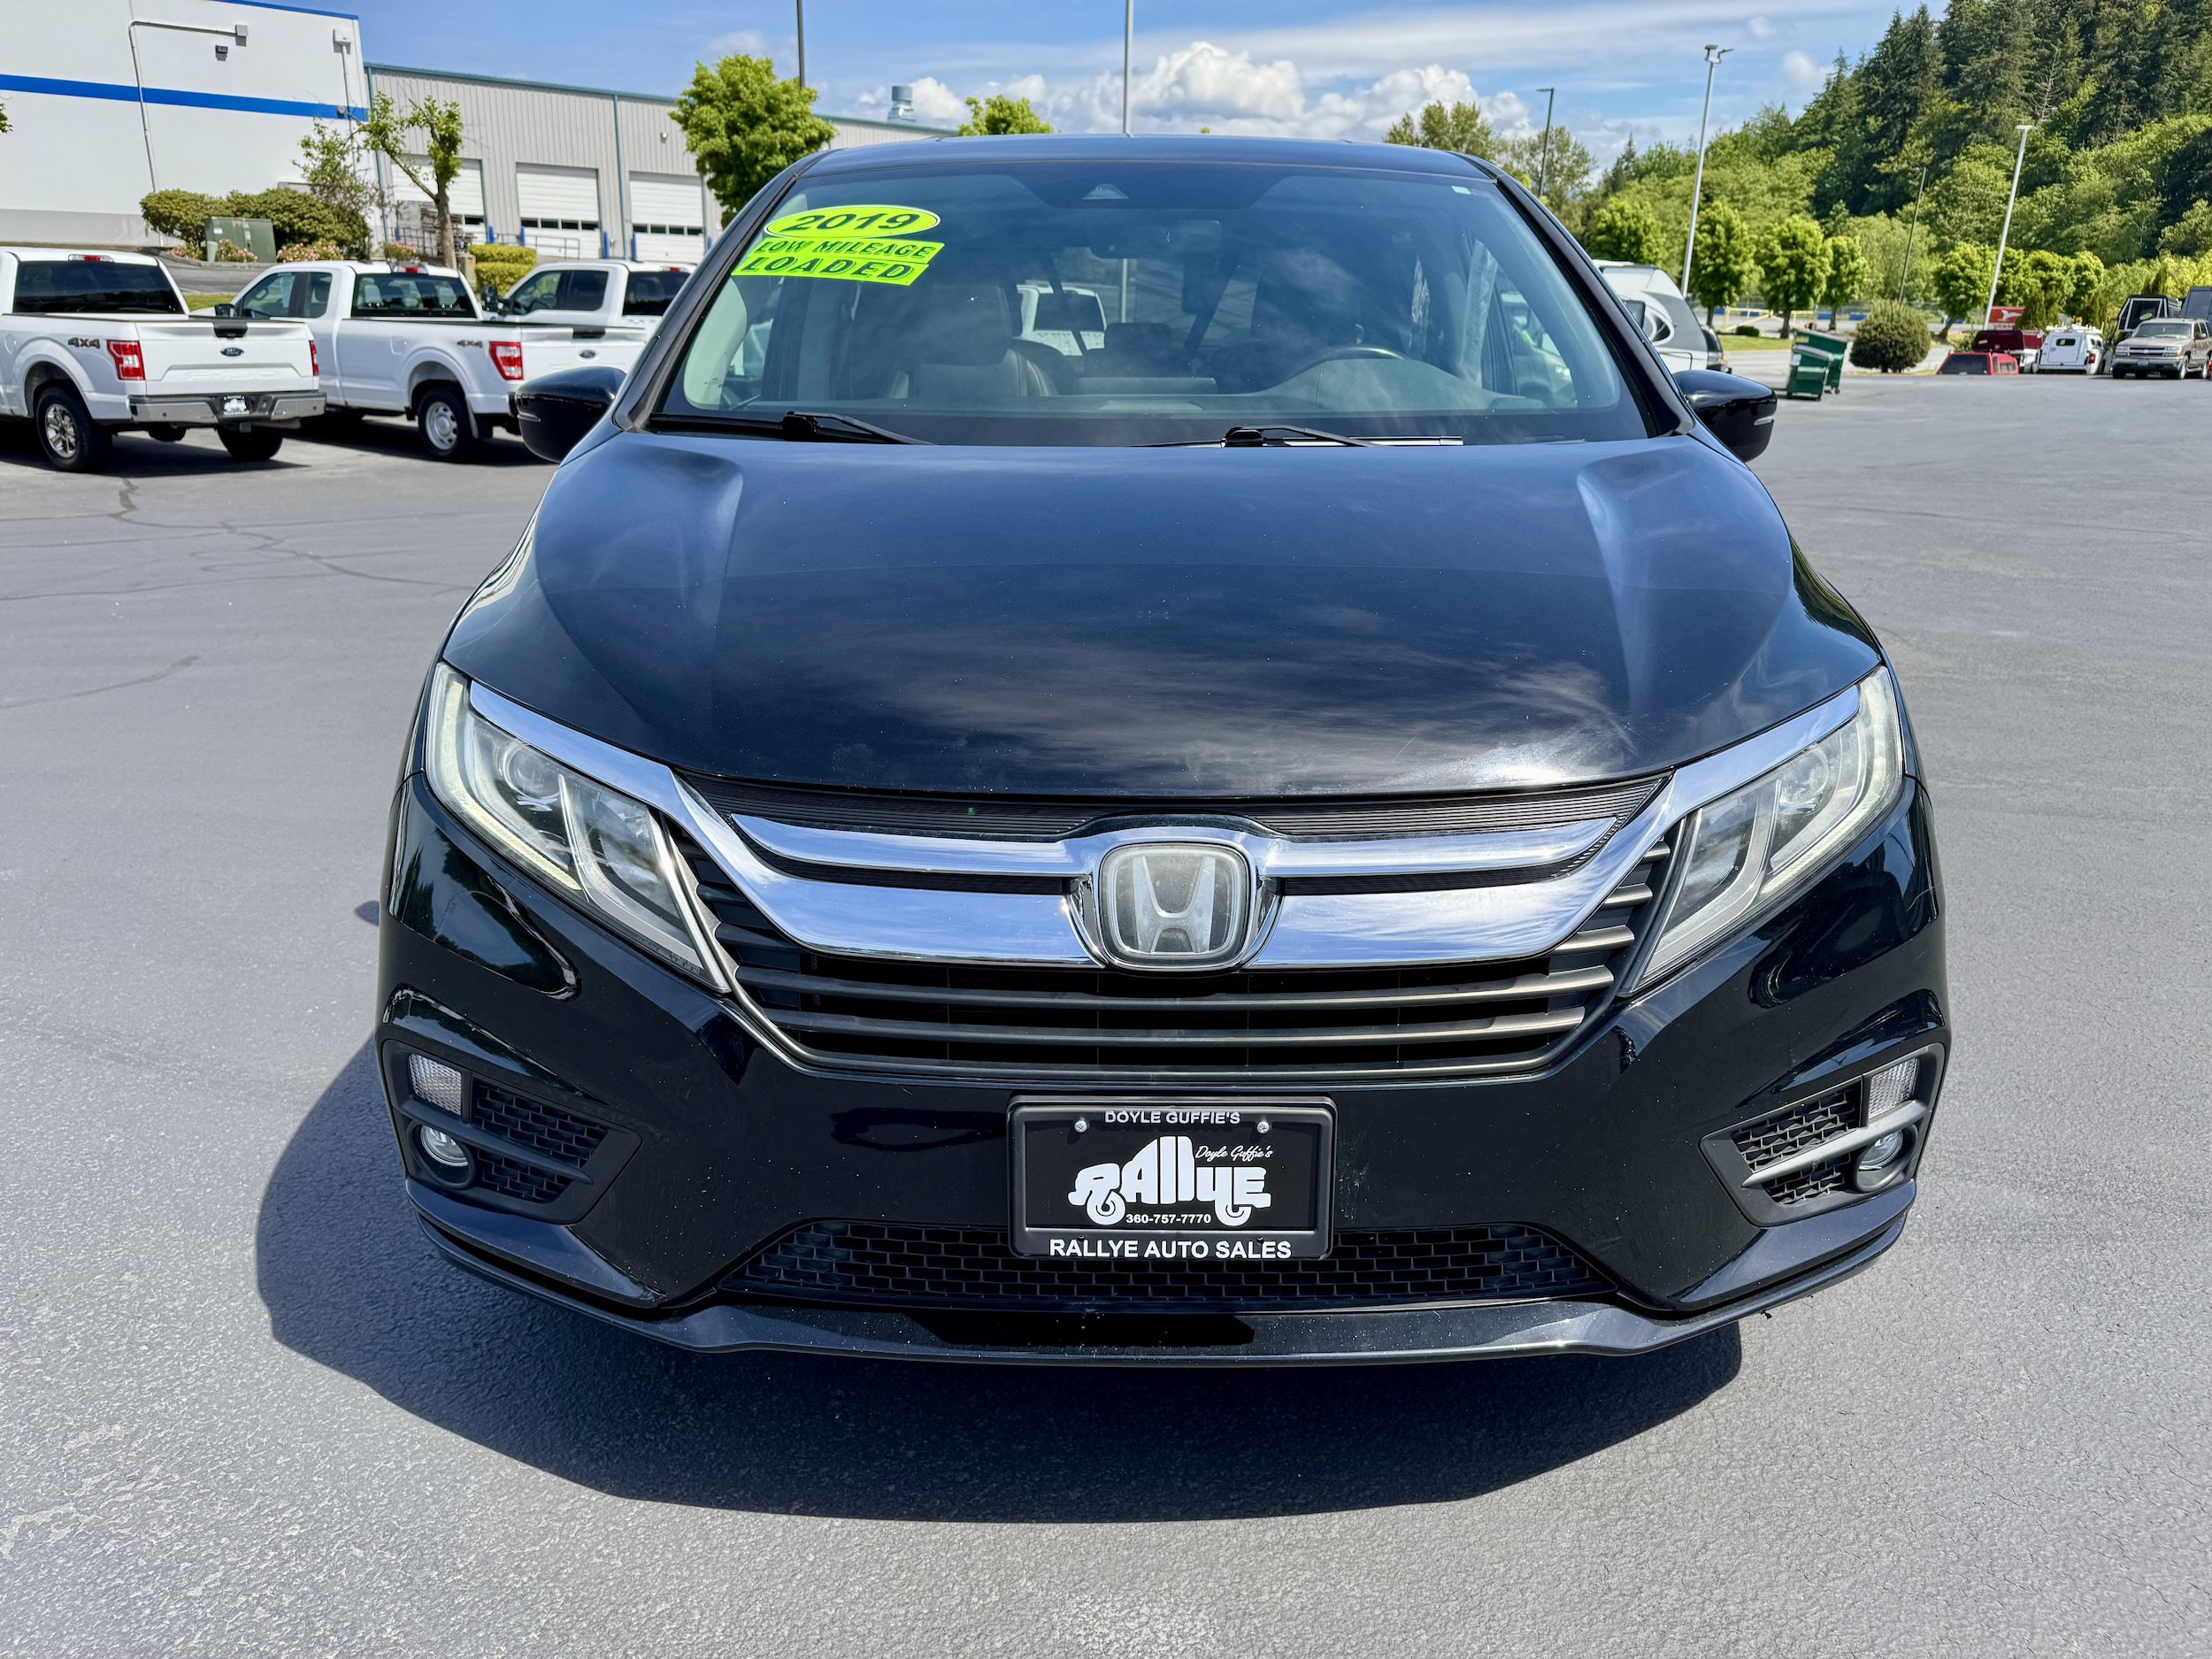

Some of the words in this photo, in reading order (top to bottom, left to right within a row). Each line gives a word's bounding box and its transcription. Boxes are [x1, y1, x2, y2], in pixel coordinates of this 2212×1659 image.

[779, 212, 921, 233] 2019
[754, 240, 818, 254] LOW
[813, 241, 937, 258] MILEAGE
[741, 257, 912, 280] LOADED
[1105, 1110, 1161, 1124] DOYLE
[1165, 1110, 1240, 1125] GUFFIE'S
[1194, 1145, 1228, 1162] Doyle
[1230, 1145, 1273, 1162] Guffie's
[1125, 1213, 1212, 1225] 360-757-7770
[1049, 1239, 1139, 1258] RALLYE
[1144, 1240, 1209, 1258] AUTO
[1215, 1240, 1292, 1259] SALES
